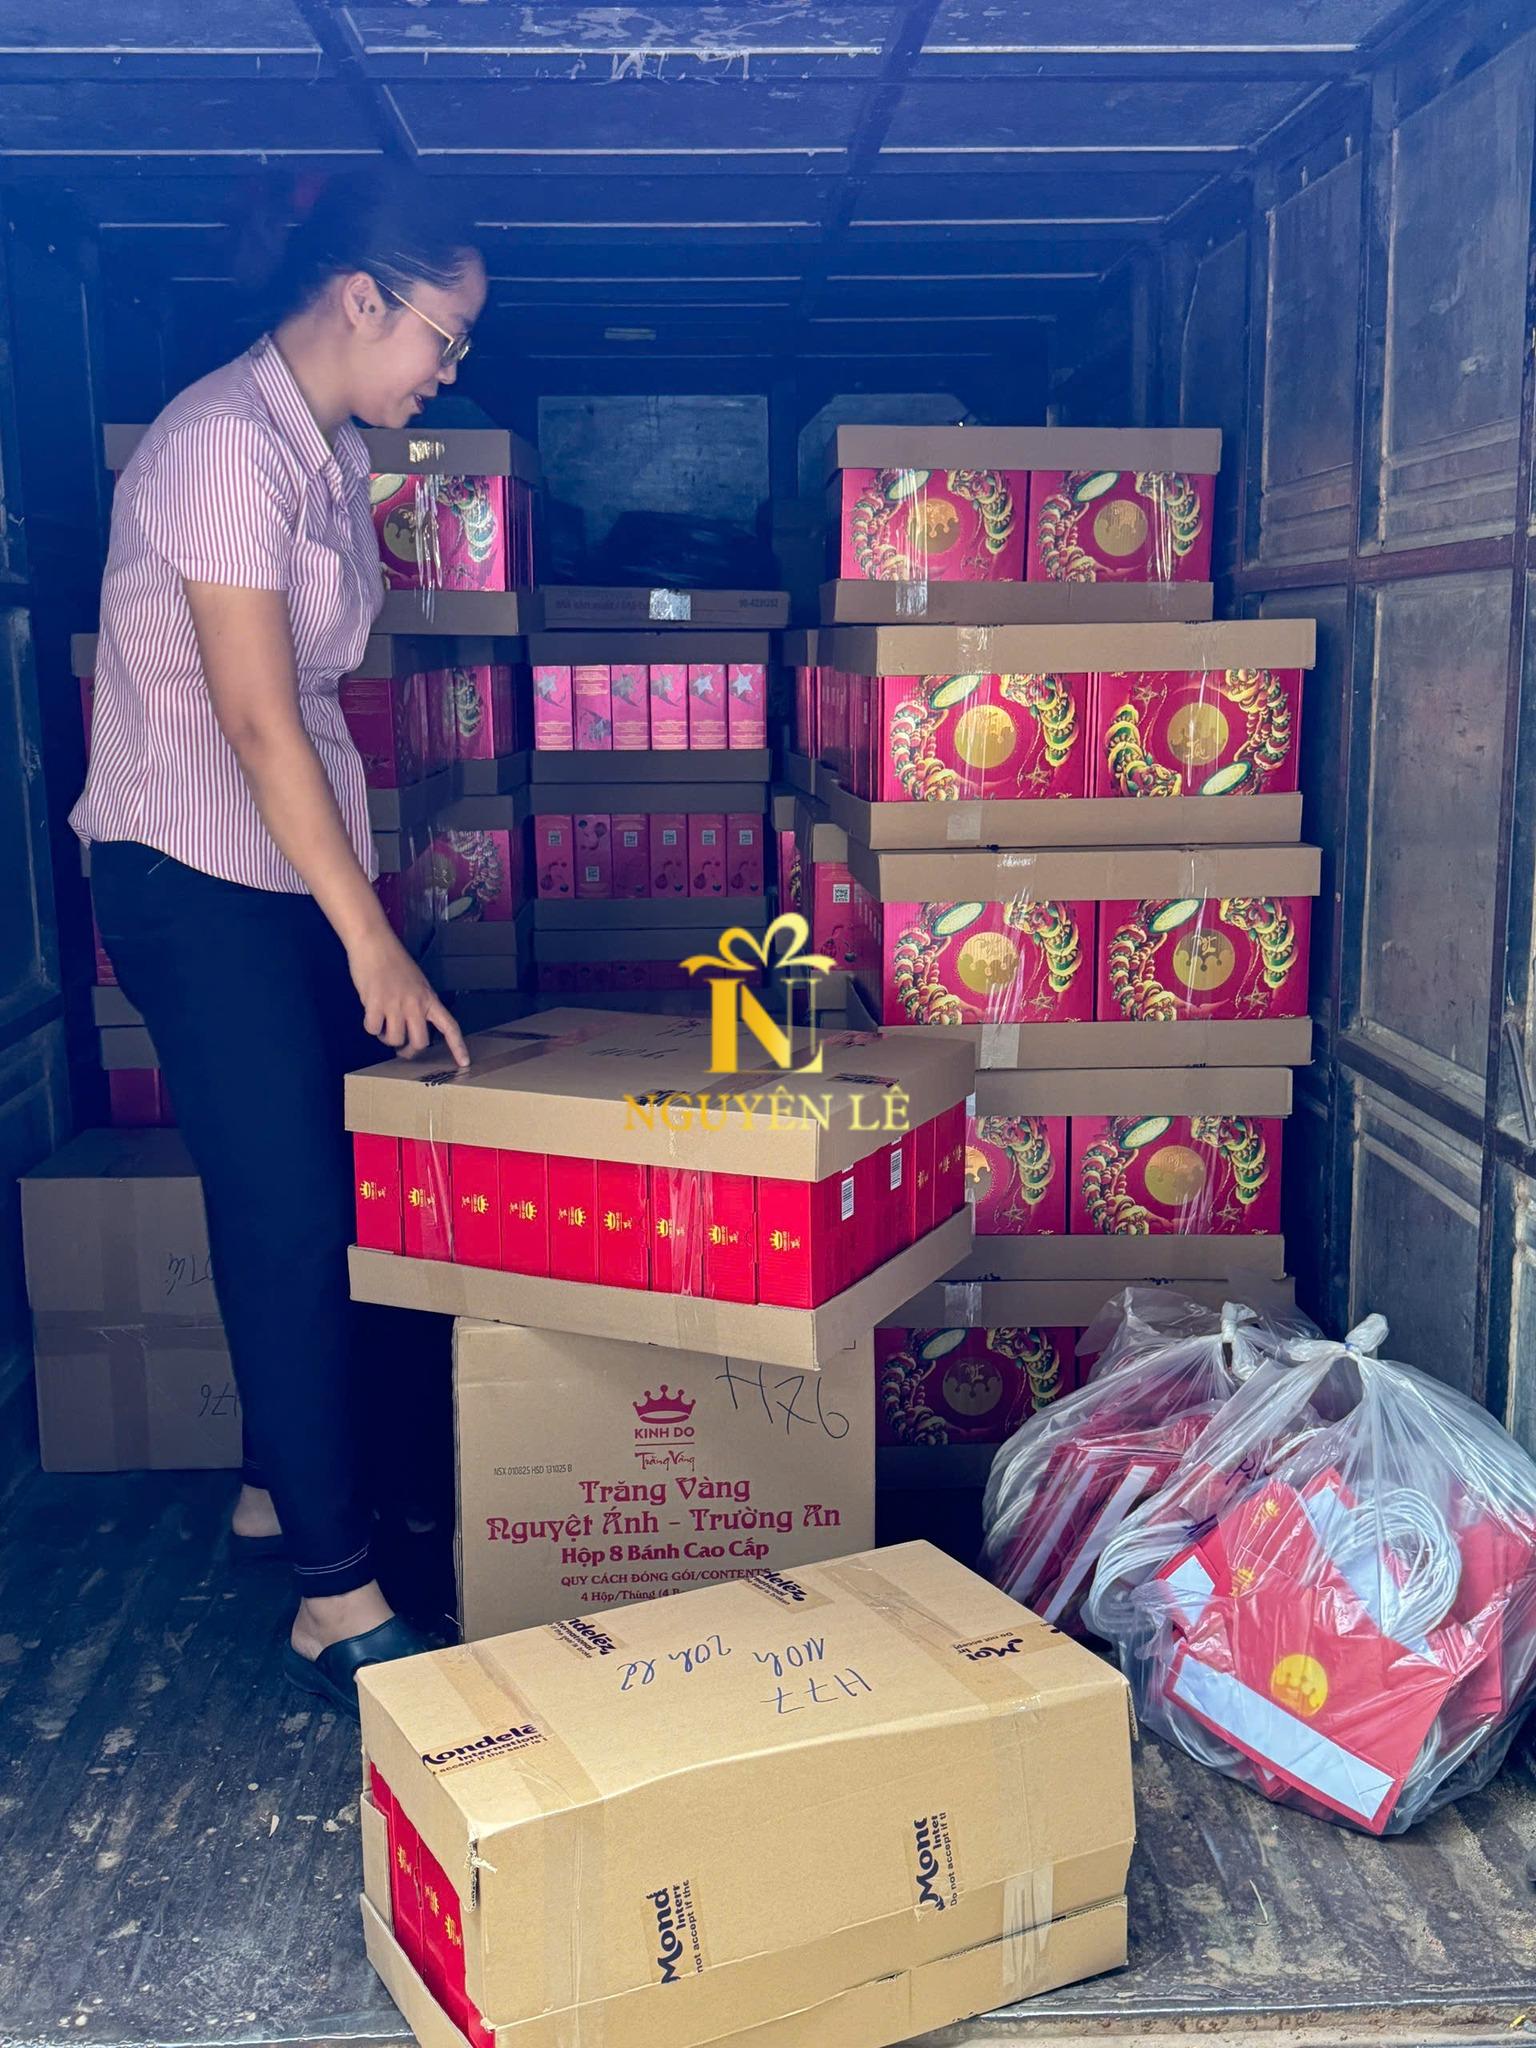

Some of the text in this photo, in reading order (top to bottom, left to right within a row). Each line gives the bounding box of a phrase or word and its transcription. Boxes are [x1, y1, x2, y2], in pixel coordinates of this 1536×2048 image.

[715, 1356, 850, 1439] H76
[634, 1426, 695, 1439] KINH DO
[578, 1476, 751, 1506] Trăng Vàng
[486, 1513, 594, 1543] Nguyệt
[602, 1506, 659, 1536] Ánh
[688, 1506, 793, 1533] Trường
[803, 1504, 841, 1527] An
[561, 1538, 770, 1568] Hộp 8 Bánh Cao Cấp
[560, 1575, 588, 1587] QUY
[591, 1572, 628, 1584] CÁCH
[631, 1570, 668, 1583] ĐÓNG
[580, 1592, 588, 1602] 4
[760, 1668, 872, 1714] H77
[943, 1832, 954, 1870] accept
[687, 1911, 700, 1951] accept
